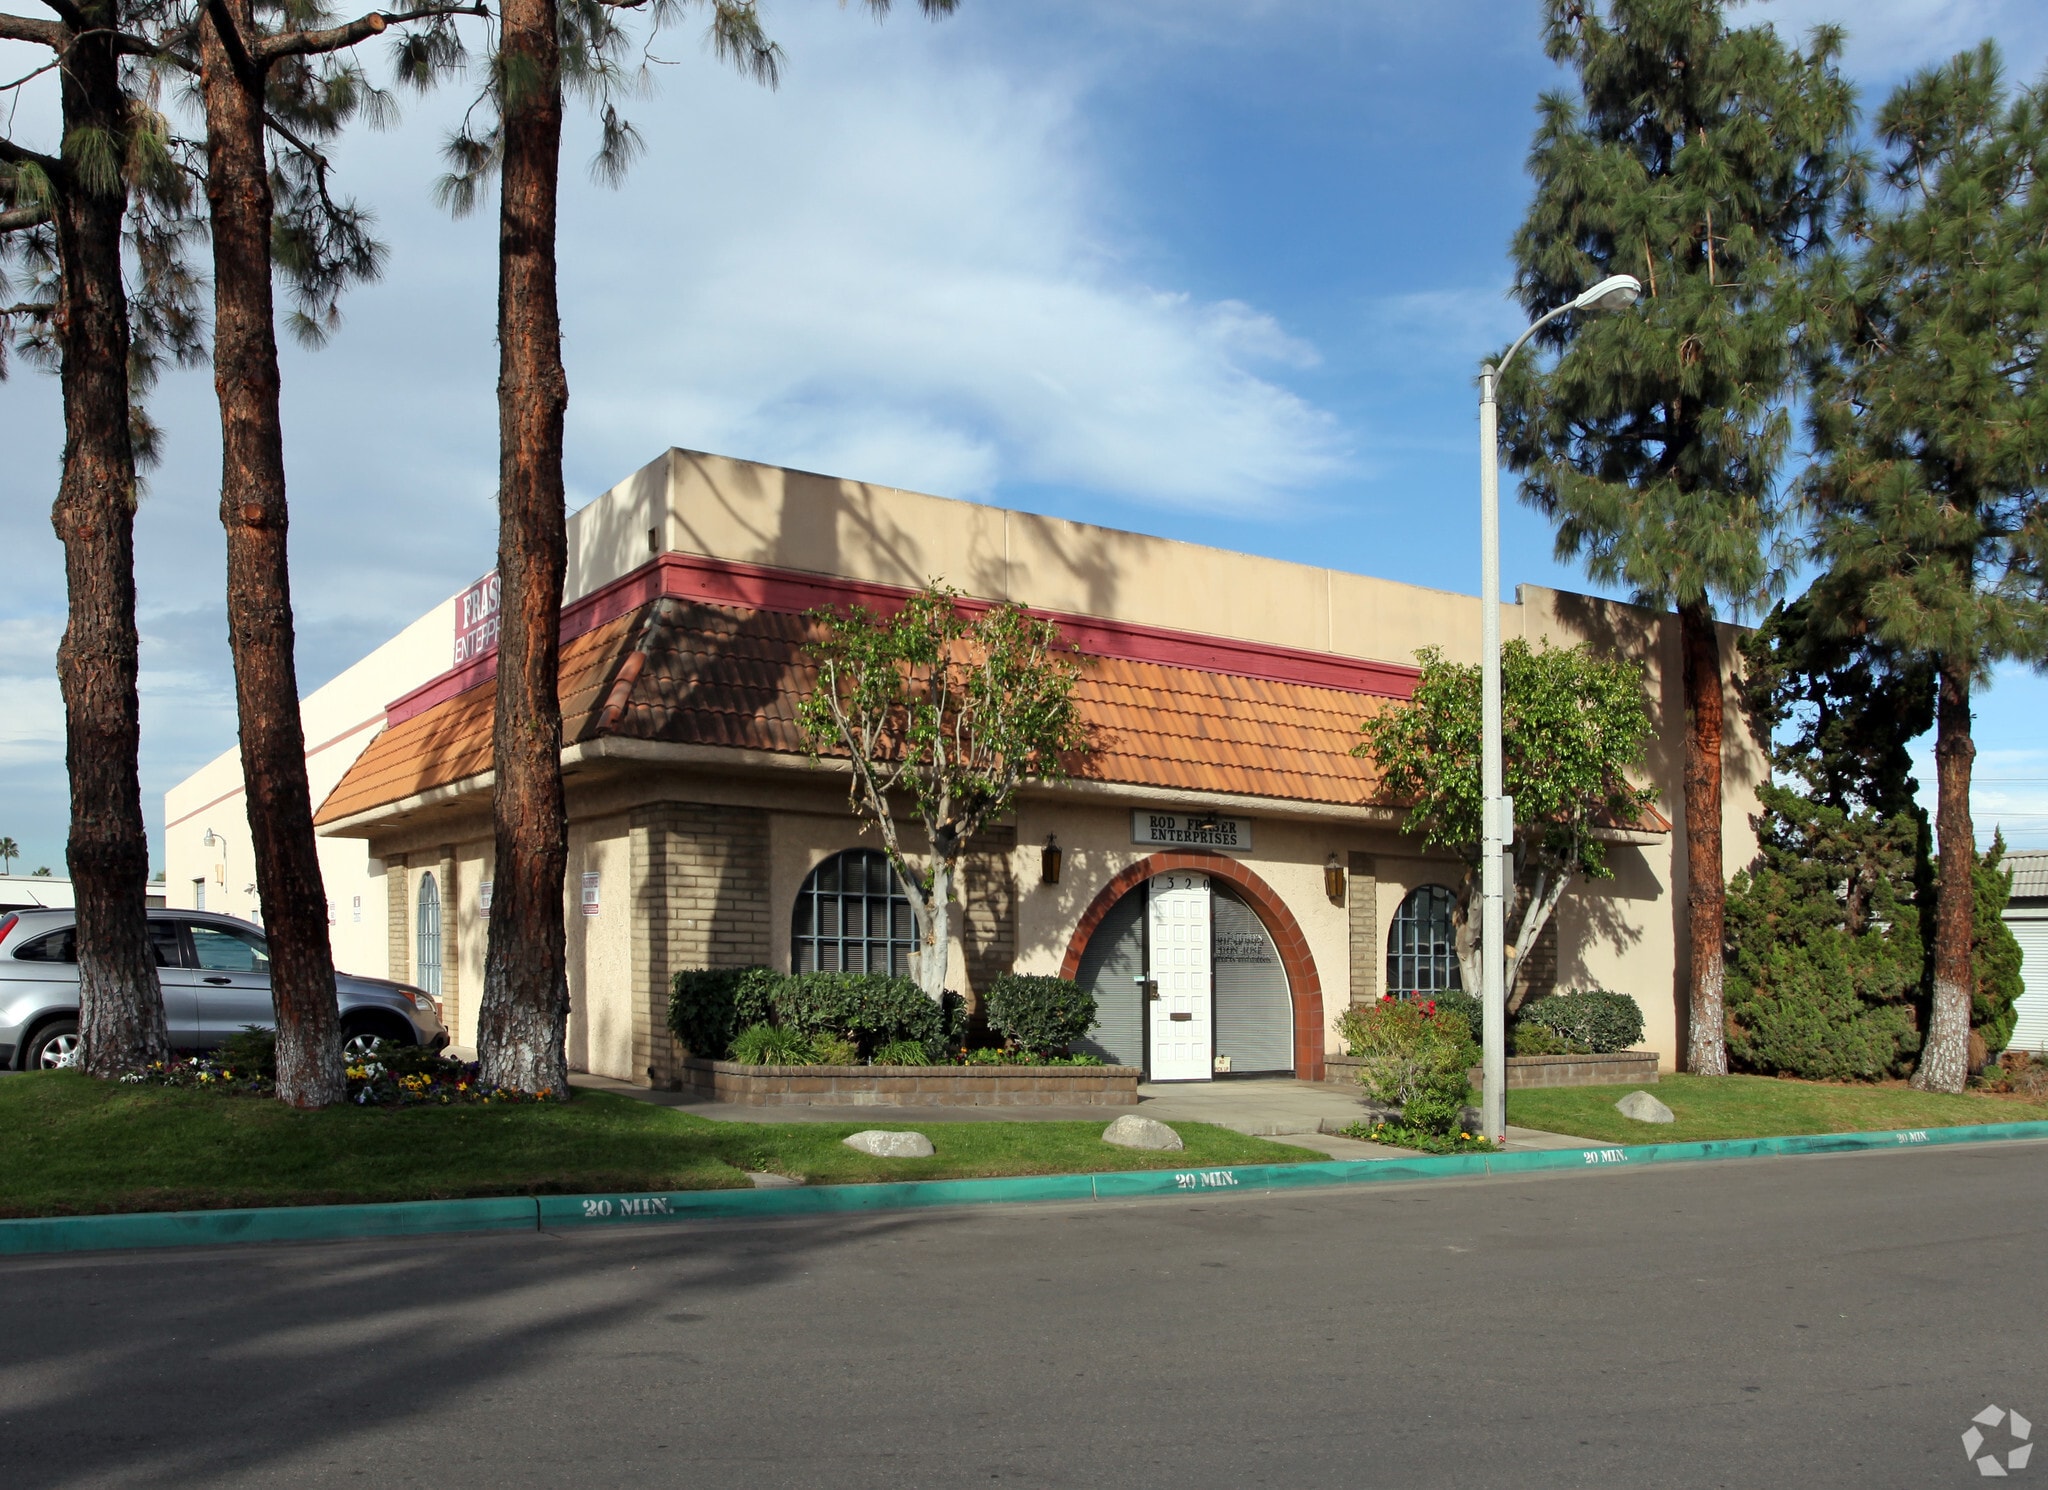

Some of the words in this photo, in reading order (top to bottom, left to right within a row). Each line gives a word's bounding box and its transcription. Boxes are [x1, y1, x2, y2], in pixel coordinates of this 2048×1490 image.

[1149, 815, 1175, 829] ROD
[1187, 818, 1237, 833] FRSER
[1150, 828, 1238, 846] ENTERPRISES
[1896, 1133, 1908, 1144] 20
[1583, 1151, 1598, 1164] 20
[1600, 1149, 1628, 1163] MIN.
[1175, 1173, 1196, 1189] 20
[1200, 1171, 1238, 1187] MIN.
[582, 1199, 612, 1217] 20
[620, 1197, 674, 1217] MIN.
